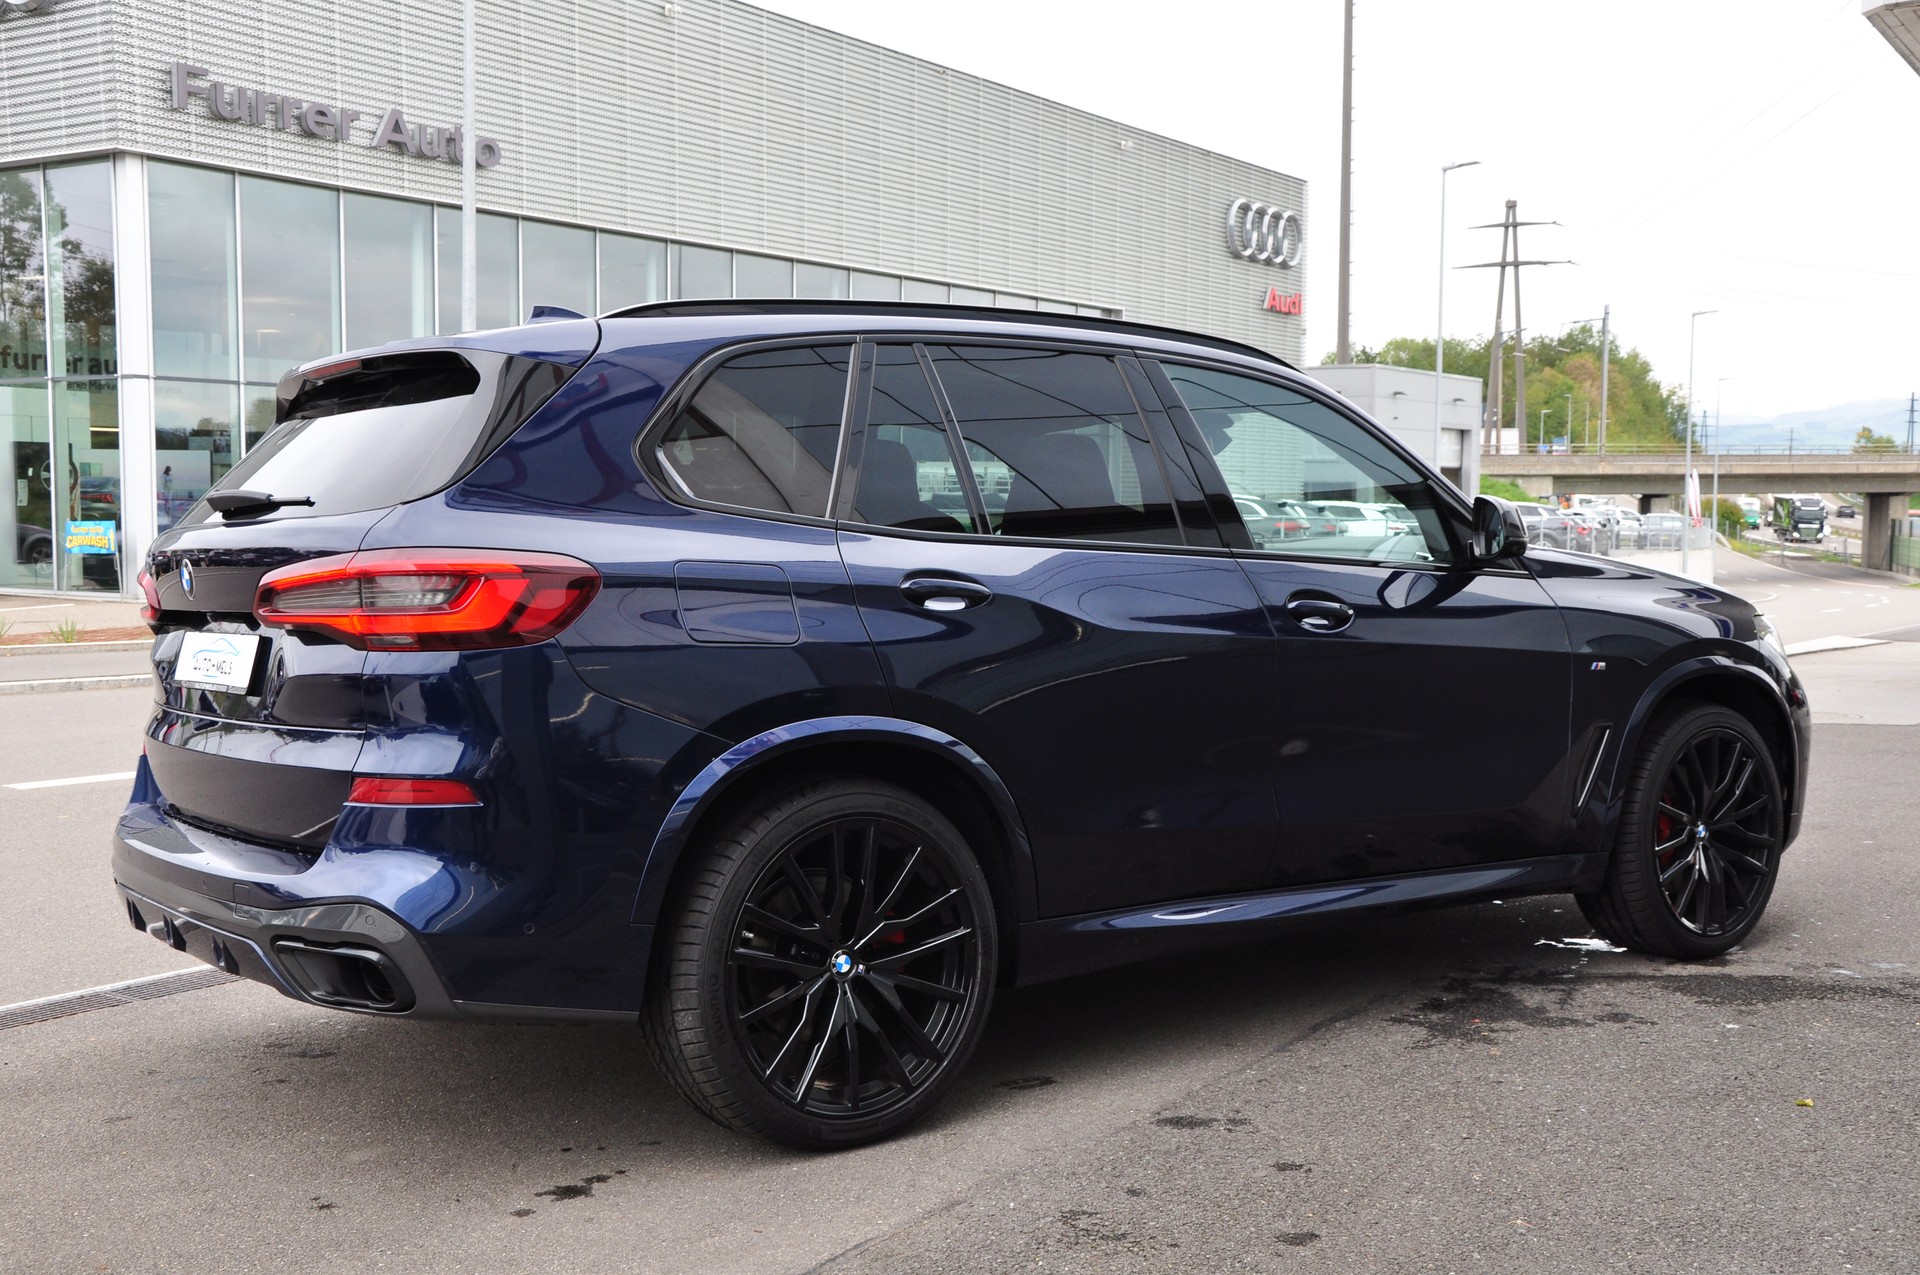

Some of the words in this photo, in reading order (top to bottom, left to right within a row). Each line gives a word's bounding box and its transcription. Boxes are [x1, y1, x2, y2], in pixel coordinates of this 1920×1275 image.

[170, 61, 360, 141] Furrer
[1262, 287, 1303, 315] Audi
[67, 535, 109, 549] CARWASH
